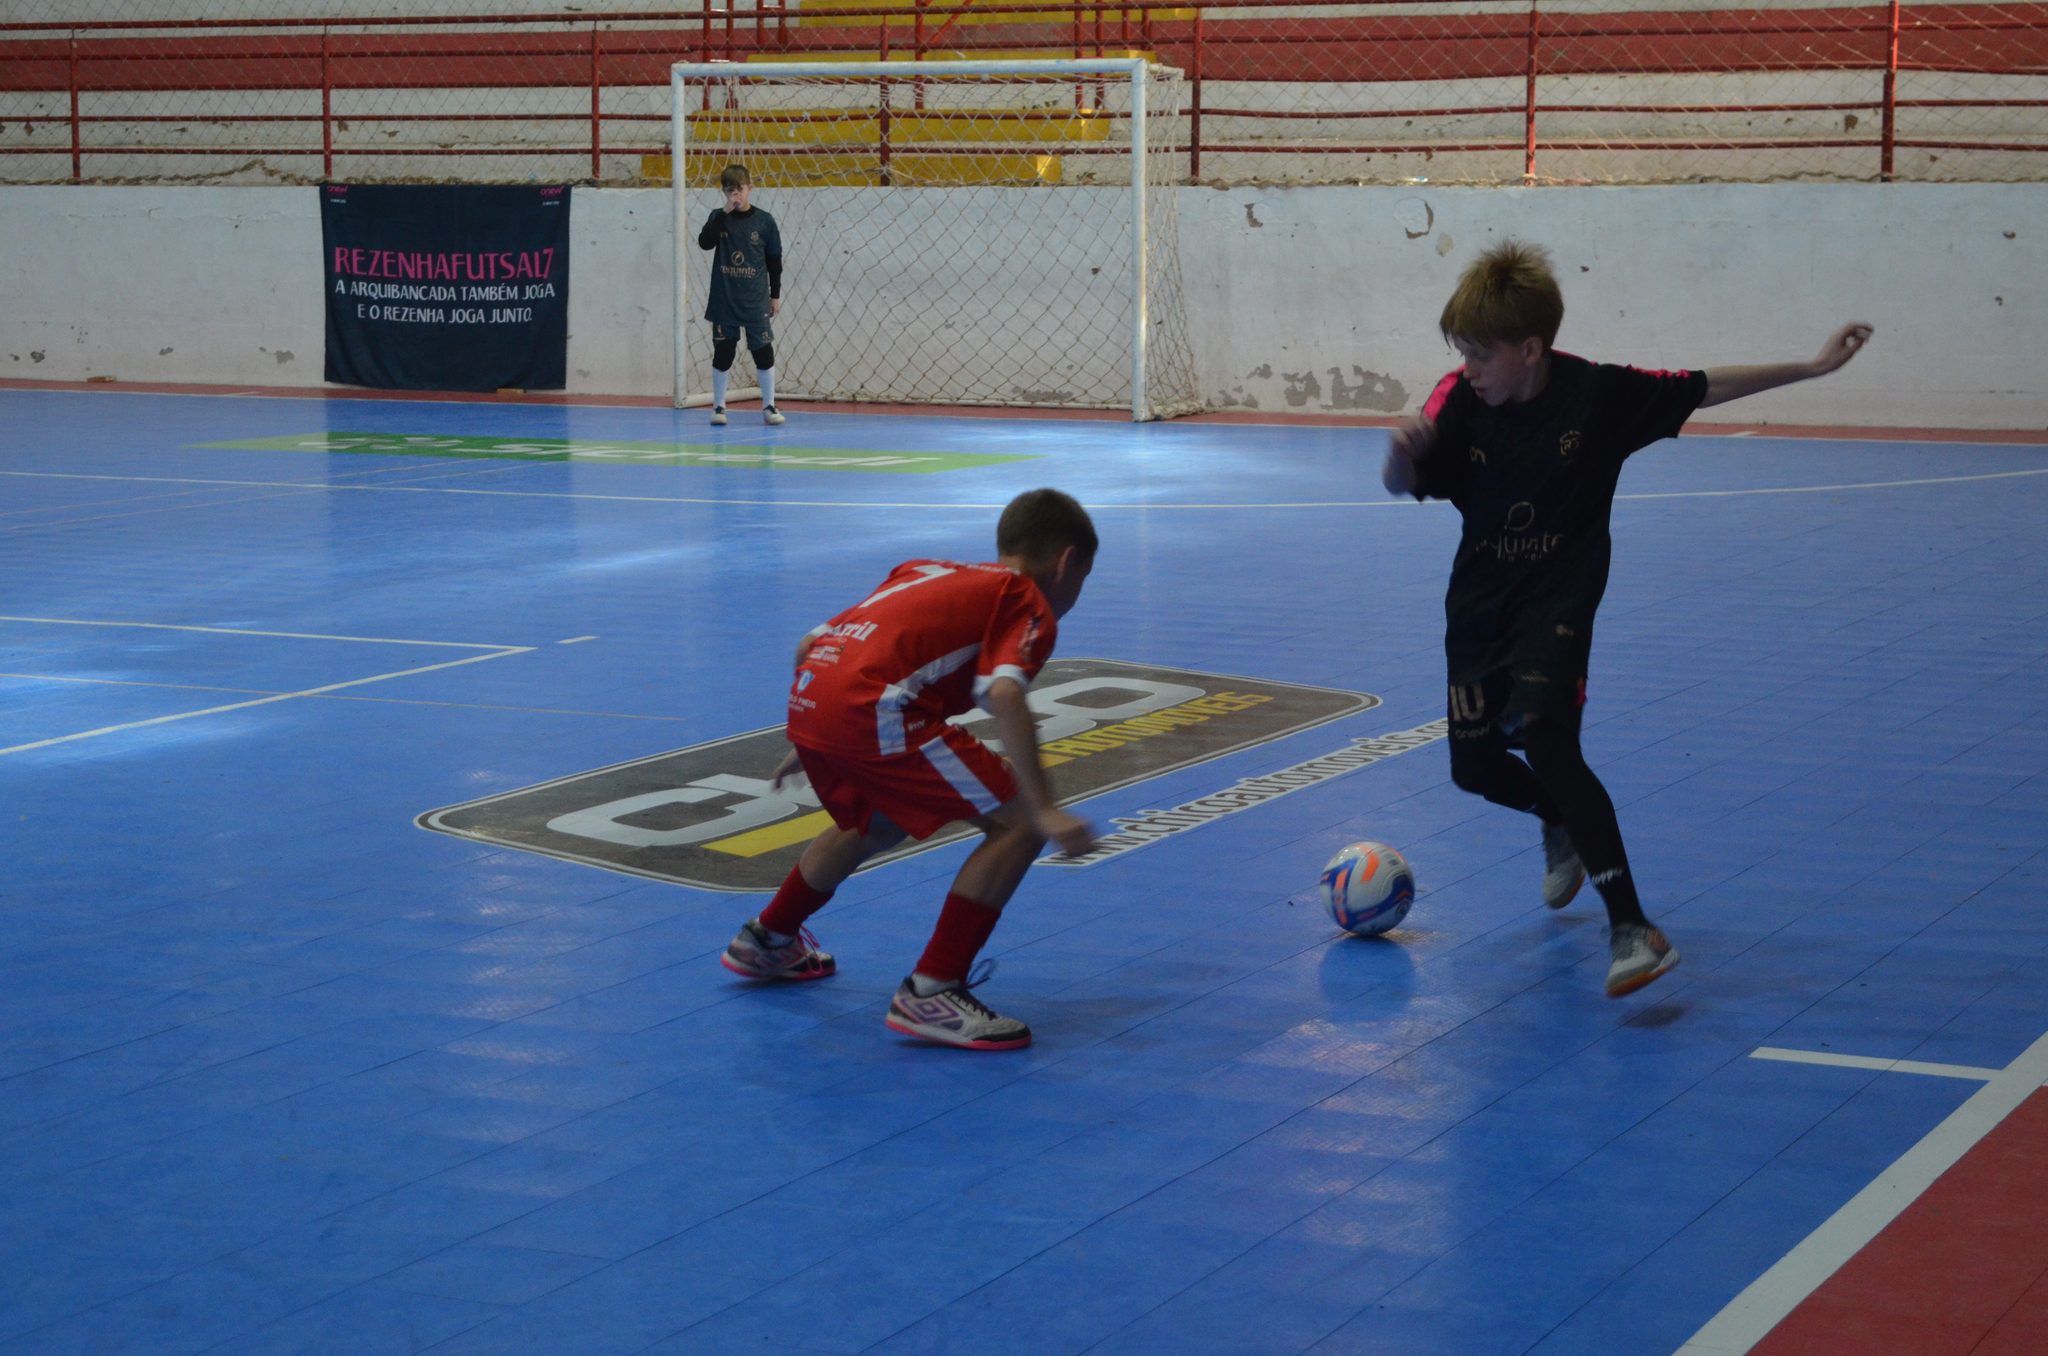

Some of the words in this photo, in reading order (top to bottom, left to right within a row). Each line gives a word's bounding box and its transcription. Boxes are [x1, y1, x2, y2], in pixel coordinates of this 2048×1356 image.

[335, 279, 346, 295] A
[350, 281, 457, 301] ARQUIBANCADA
[460, 283, 518, 301] TAMBÉM
[522, 283, 556, 300] JOGA
[357, 304, 366, 319] E
[369, 304, 380, 320] O
[383, 306, 446, 323] REZENHA
[448, 308, 485, 324] JOGA
[454, 443, 942, 467] Sicredi
[1450, 683, 1486, 722] 10
